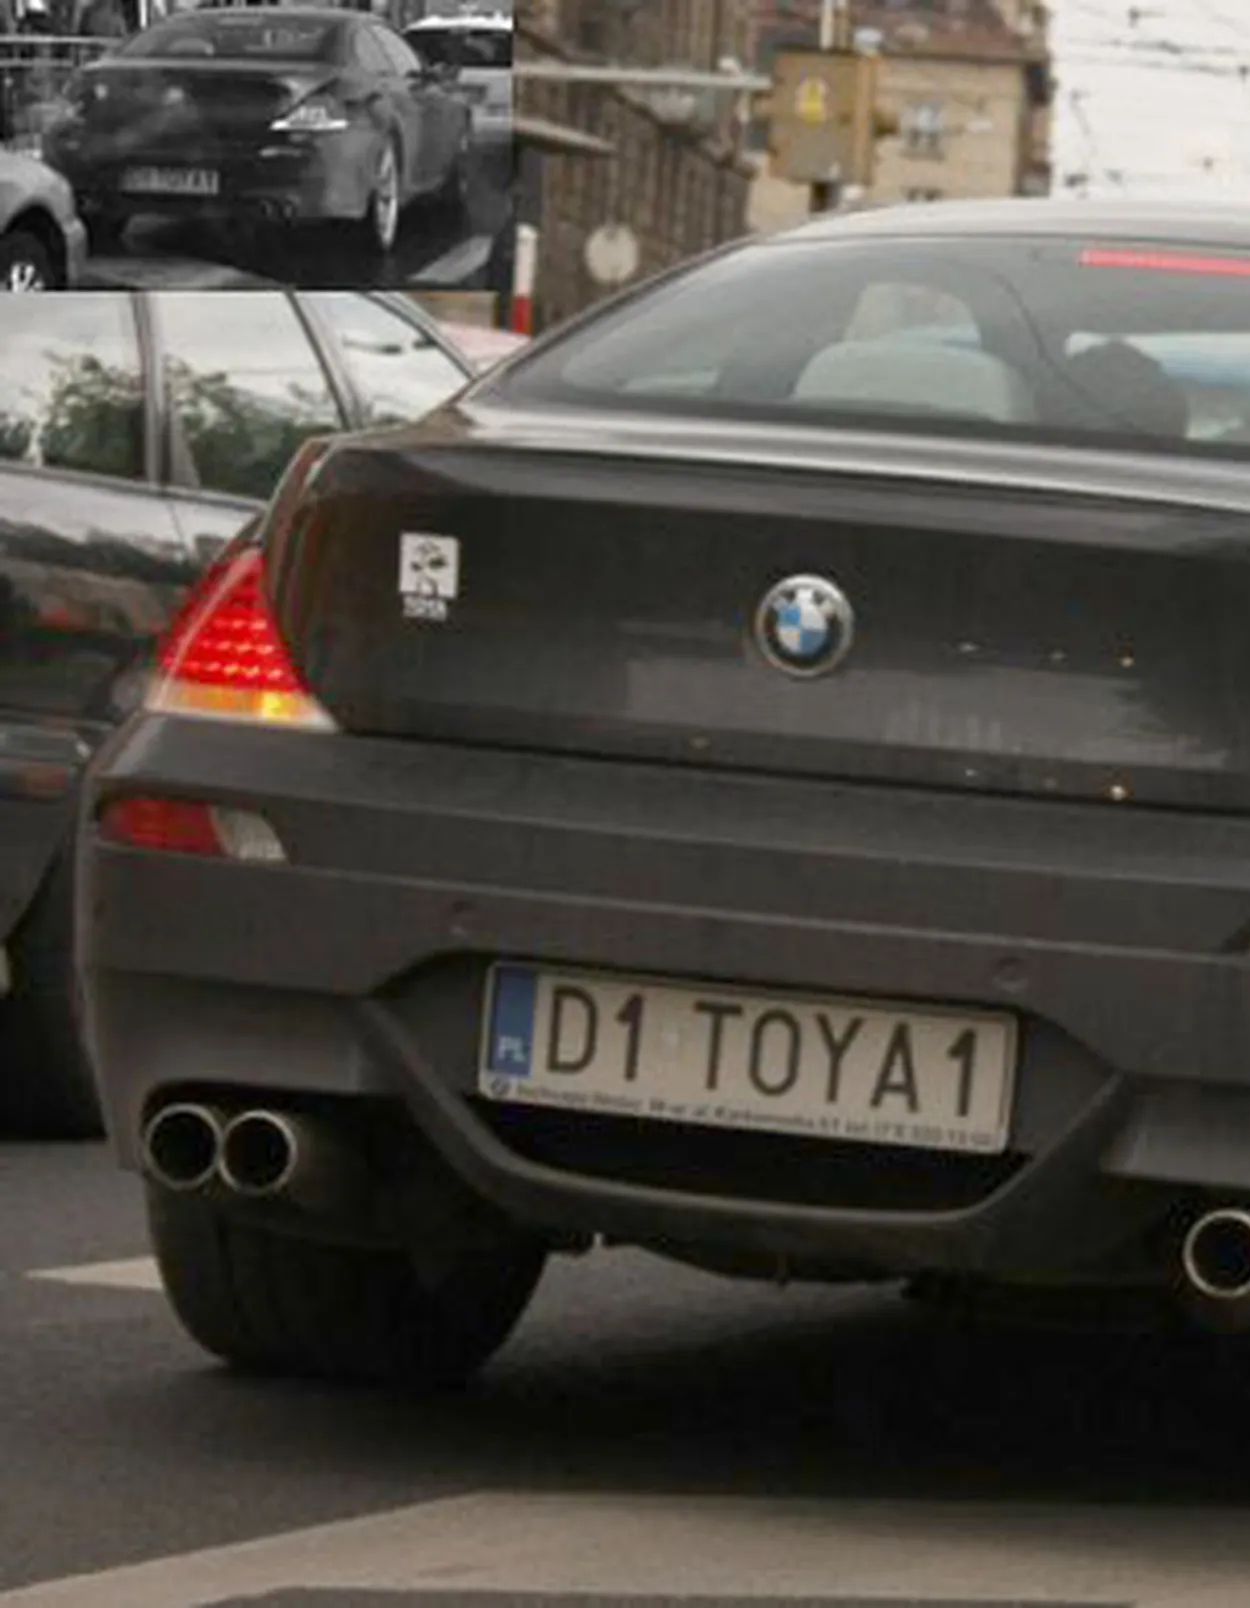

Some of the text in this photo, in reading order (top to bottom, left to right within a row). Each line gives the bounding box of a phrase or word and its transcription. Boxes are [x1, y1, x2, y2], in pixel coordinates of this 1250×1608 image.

[498, 1036, 526, 1062] PL
[546, 984, 645, 1080] D1
[693, 999, 978, 1118] TOYA1
